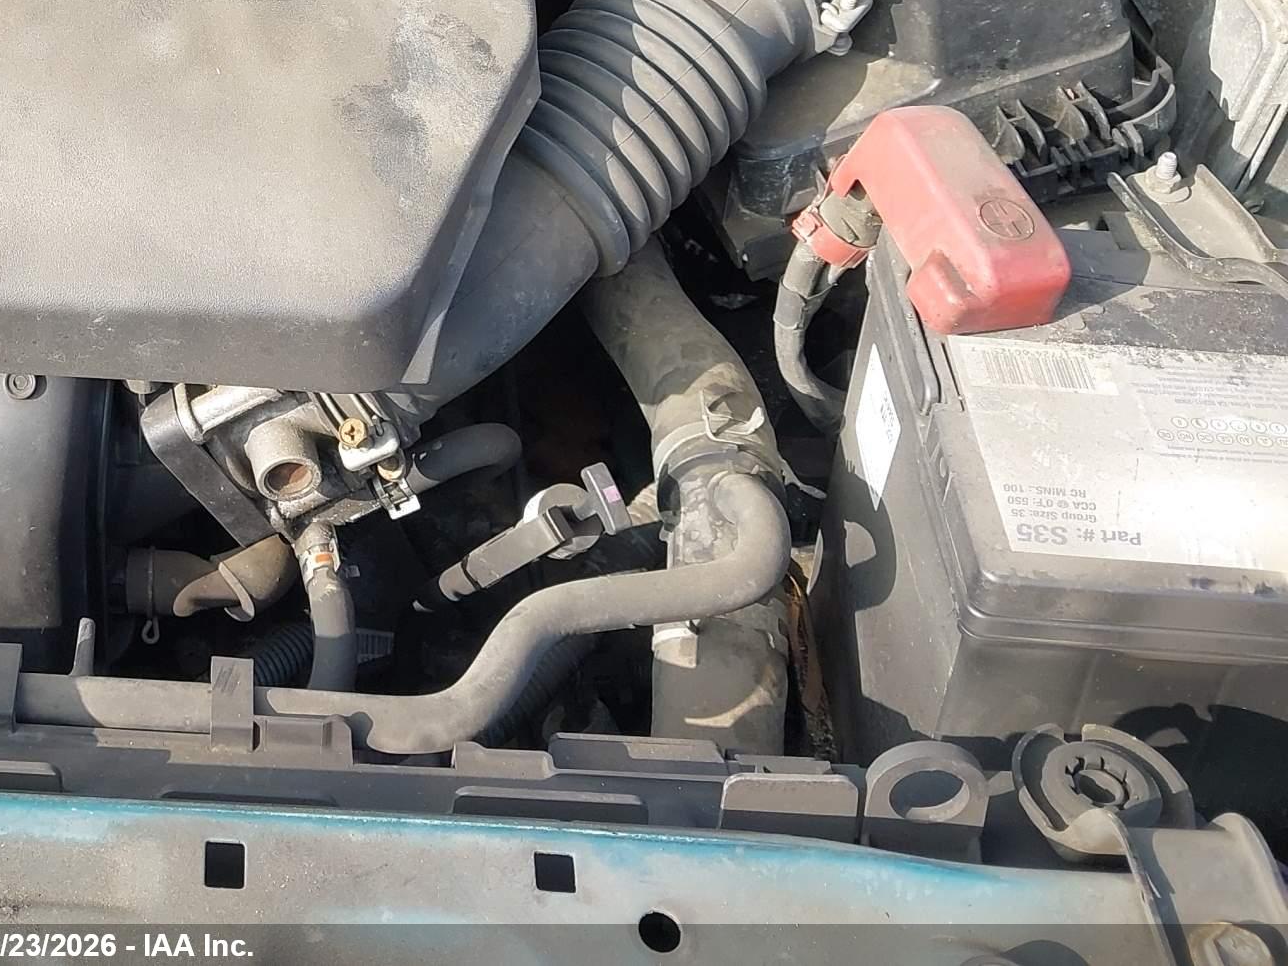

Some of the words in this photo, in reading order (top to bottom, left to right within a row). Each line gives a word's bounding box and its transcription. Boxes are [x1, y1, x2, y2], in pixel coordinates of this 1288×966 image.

[1003, 484, 1024, 493] 100
[1070, 488, 1086, 498] RC
[1008, 496, 1028, 506] 550
[1073, 500, 1097, 511] CCA
[1011, 508, 1026, 518] 35
[1029, 509, 1057, 521] Size:
[1061, 512, 1097, 523] Group
[1016, 523, 1068, 546] S35
[1076, 527, 1095, 542] #:
[1100, 529, 1142, 546] Part
